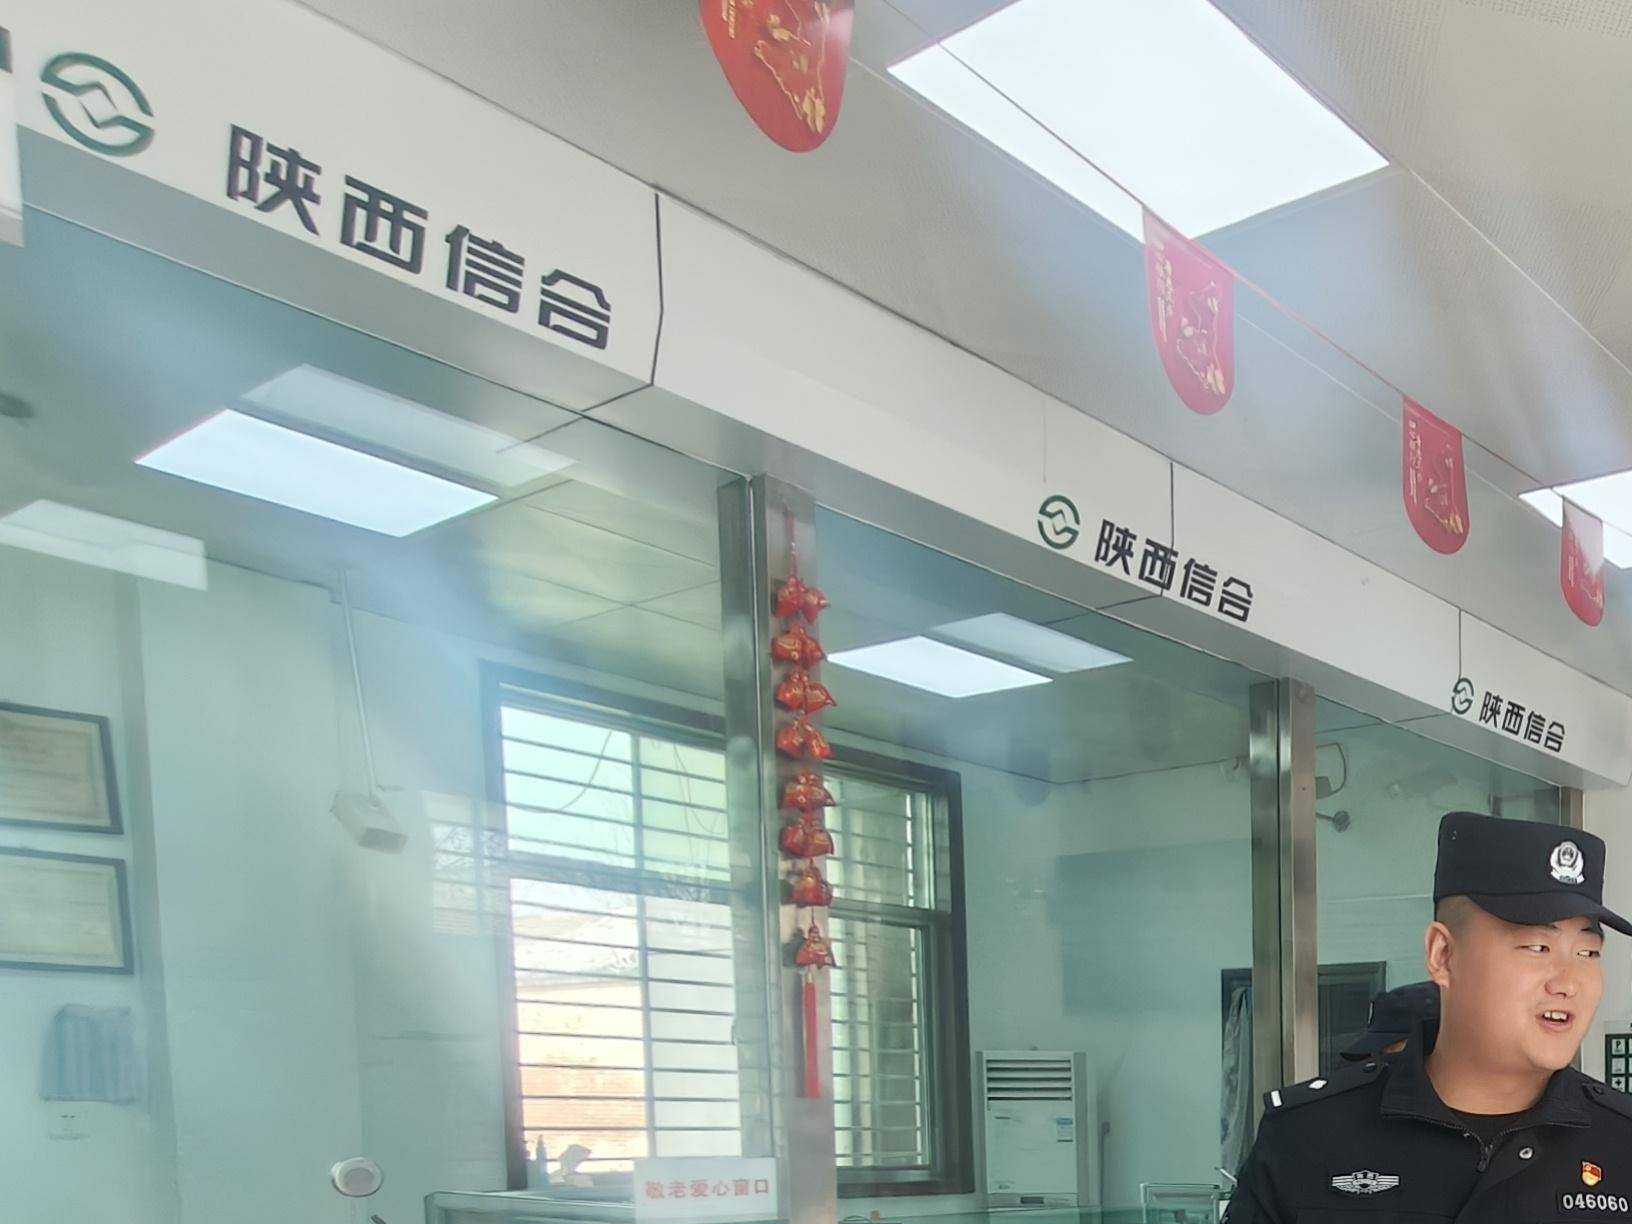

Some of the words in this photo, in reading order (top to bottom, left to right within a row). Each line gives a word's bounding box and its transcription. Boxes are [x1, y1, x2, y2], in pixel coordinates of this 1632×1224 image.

[225, 124, 611, 349] 陕西信合
[1095, 518, 1253, 622] 陕西信合
[1479, 691, 1565, 753] 陕西信合
[645, 1178, 769, 1199] 敬老爱心窗口
[1562, 1193, 1628, 1213] 046060
